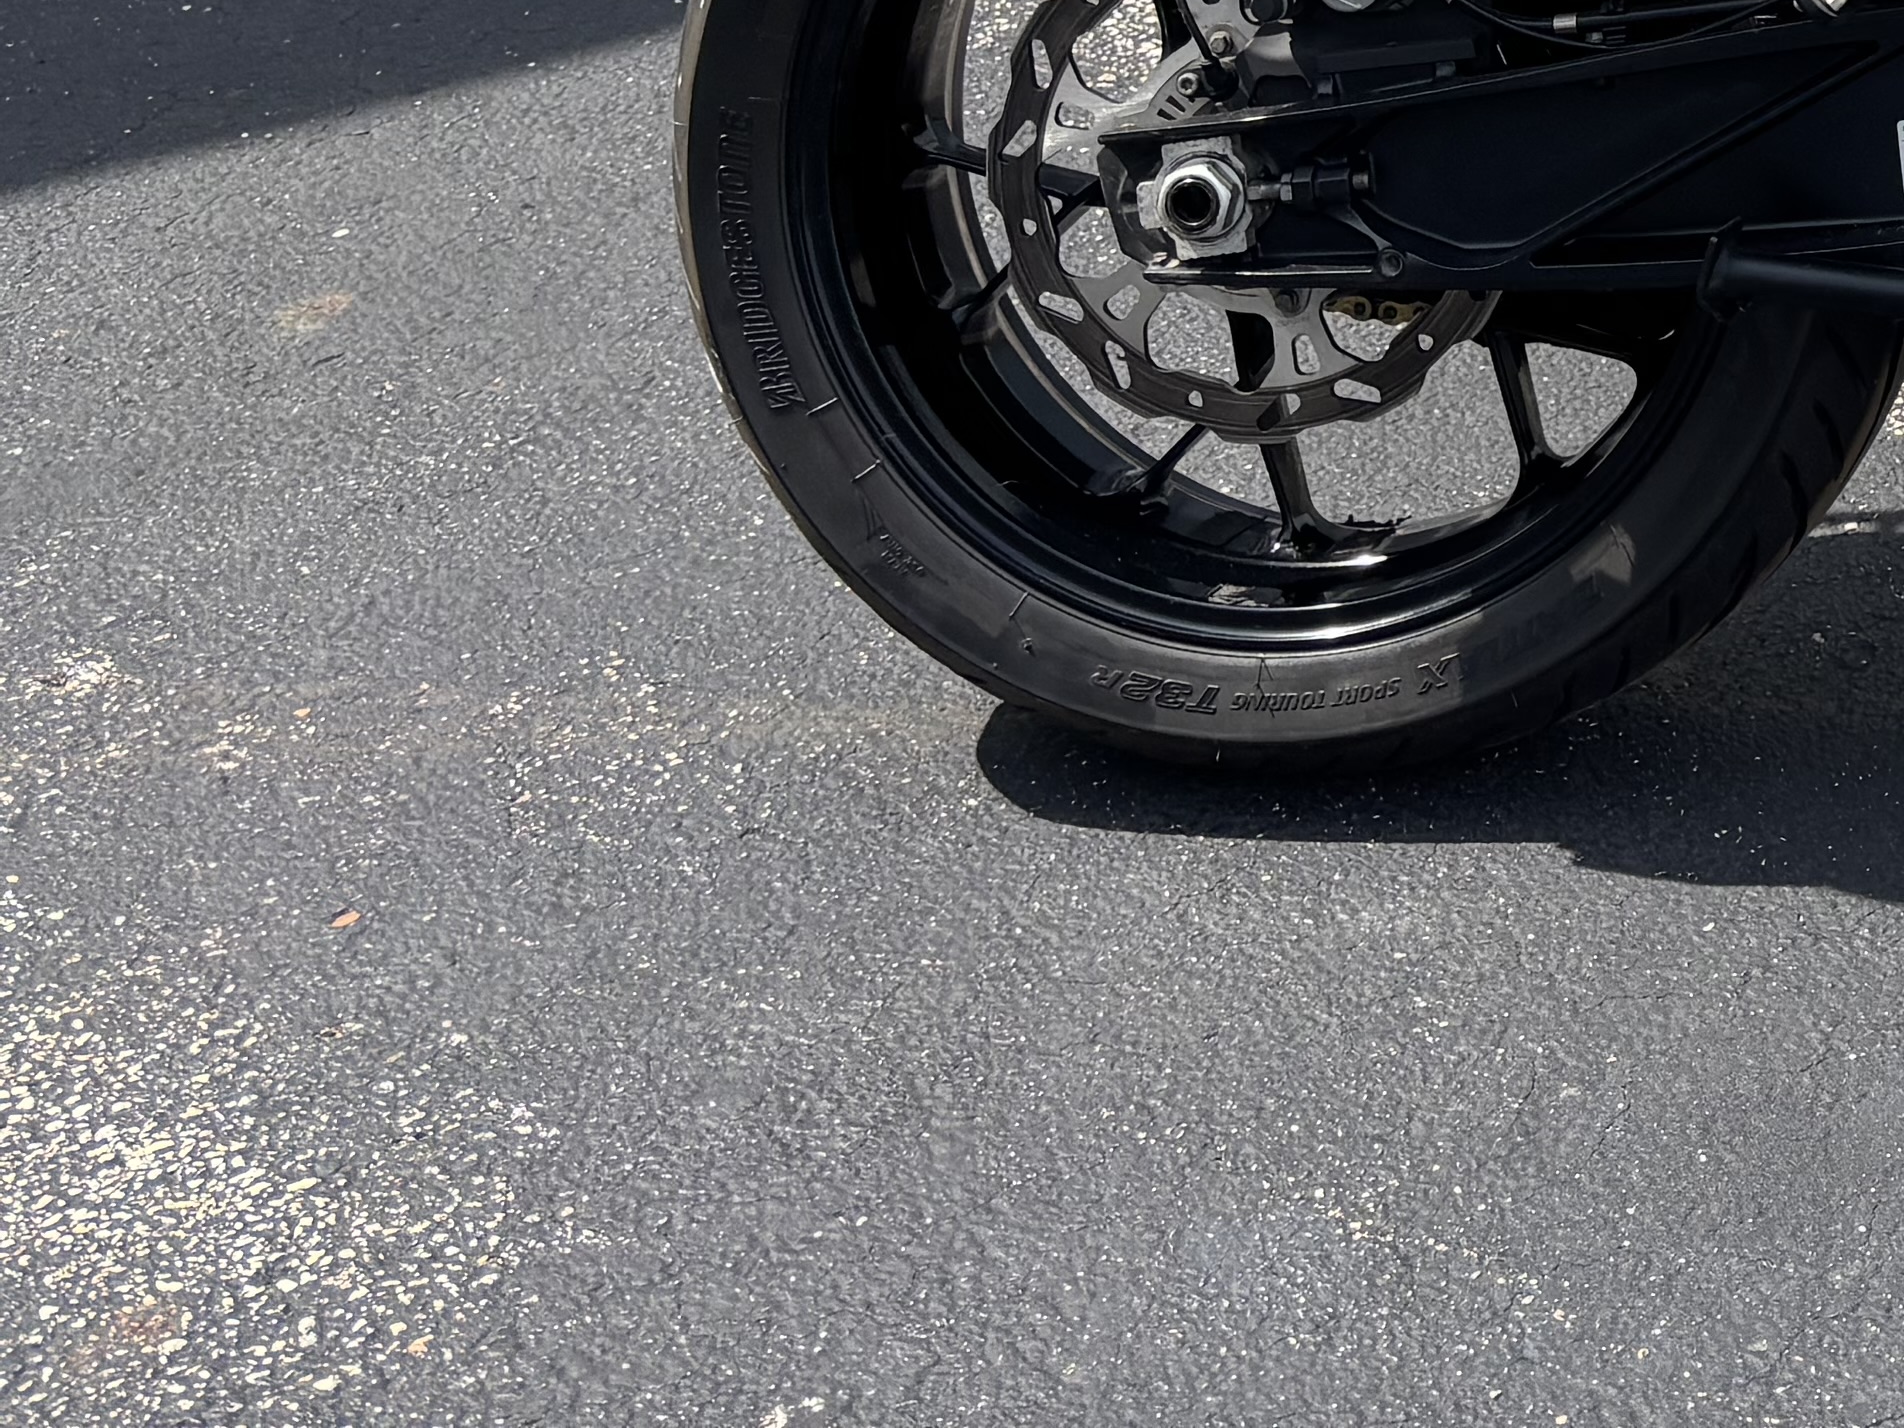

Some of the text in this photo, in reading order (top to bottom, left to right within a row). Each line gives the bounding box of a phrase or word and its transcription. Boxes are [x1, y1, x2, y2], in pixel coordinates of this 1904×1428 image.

[717, 106, 806, 409] BRIDGESTONE
[1229, 688, 1325, 712] TOURING
[1329, 676, 1402, 707] SPORT
